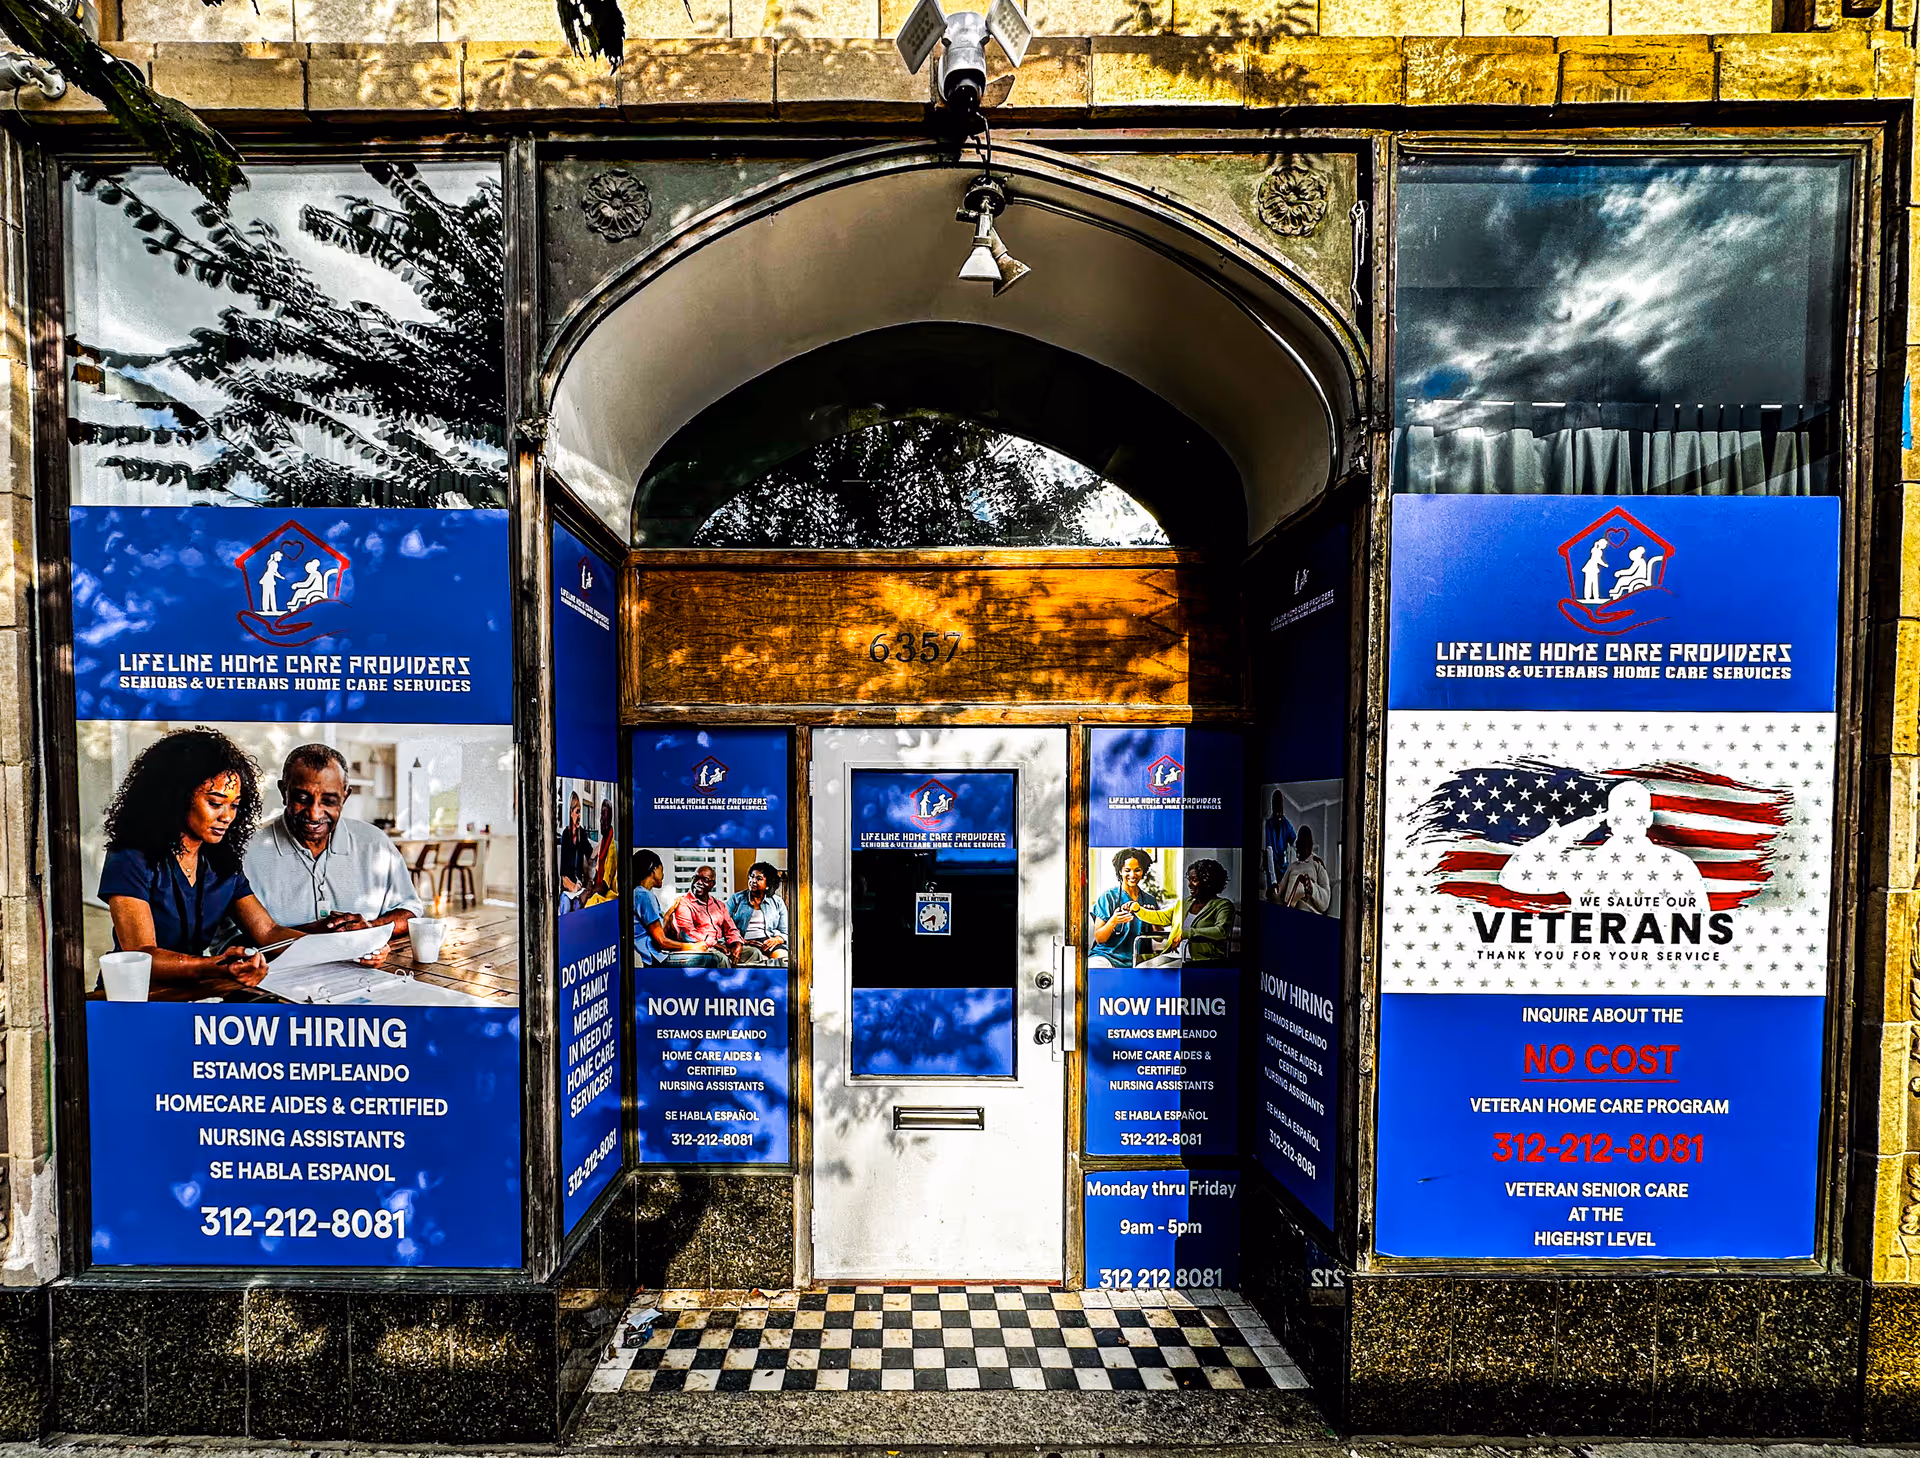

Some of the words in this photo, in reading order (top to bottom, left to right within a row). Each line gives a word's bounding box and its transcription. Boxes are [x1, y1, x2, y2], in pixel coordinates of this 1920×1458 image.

[870, 631, 964, 662] 6357
[1436, 642, 1532, 661] LIFELINE
[1539, 643, 1599, 661] HOME
[1605, 643, 1663, 662] CARE
[1669, 643, 1792, 663] PROVIDERS
[120, 653, 213, 672] LIFELINE
[221, 654, 278, 673] HOME
[286, 655, 342, 673] CARE
[350, 655, 471, 675] PROVIDERS
[1435, 665, 1505, 678] SENIORS
[1507, 665, 1521, 678] &
[1523, 665, 1608, 679] VETERANS
[1613, 666, 1660, 679] HOME
[1665, 666, 1708, 679] CARE
[1713, 666, 1792, 680] SERVICES
[120, 676, 187, 689] SENIORS
[190, 677, 203, 689] &
[205, 677, 289, 690] VETERANS
[294, 678, 341, 691] HOME
[346, 678, 388, 691] CARE
[393, 679, 471, 692] SERVICES
[653, 797, 685, 805] LIFELINE
[687, 797, 706, 805] HOME
[707, 797, 726, 805] CARE
[728, 797, 767, 805] PROVIDERS
[861, 833, 900, 841] LIFELINE
[903, 833, 927, 841] HOME
[929, 833, 953, 841] CARE
[955, 833, 1006, 841] PROVIDERS
[1580, 897, 1600, 907] WE
[1607, 897, 1660, 907] SALUTE
[1667, 897, 1697, 908] OUR
[1473, 912, 1734, 945] VETERANS
[1477, 950, 1526, 960] THANK
[1535, 950, 1564, 960] YOU
[1573, 950, 1601, 961] FOR
[1609, 951, 1649, 961] YOUR
[1657, 951, 1720, 961] SERVICE
[562, 964, 576, 988] DO
[578, 954, 595, 980] YOU
[597, 945, 616, 971] HAVE
[573, 989, 580, 1010] A
[581, 972, 609, 1005] FAMILY
[1261, 971, 1287, 1001] NOW
[1290, 983, 1333, 1024] HIRING
[648, 998, 699, 1016] NOW
[704, 998, 775, 1017] HIRING
[1099, 997, 1151, 1016] NOW
[1155, 997, 1226, 1016] HIRING
[1522, 1007, 1588, 1023] INQUIRE
[1592, 1008, 1648, 1023] ABOUT
[1652, 1009, 1683, 1023] THE
[574, 997, 608, 1036] MEMBER
[194, 1015, 280, 1046] NOW
[289, 1017, 407, 1049] HIRING
[657, 1030, 703, 1039] ESTAMOS
[705, 1030, 767, 1039] EMPLEANDO
[1107, 1029, 1154, 1039] ESTAMOS
[1156, 1029, 1217, 1039] EMPLEANDO
[1264, 1008, 1289, 1030] ESTAMOS
[1290, 1021, 1327, 1050] EMPLEANDO
[569, 1042, 578, 1066] IN
[580, 1027, 601, 1058] NEED
[602, 1017, 613, 1040] OF
[662, 1051, 692, 1060] HOME
[694, 1051, 721, 1061] CARE
[723, 1052, 752, 1061] AIDES
[754, 1052, 761, 1061] &
[1112, 1051, 1143, 1060] HOME
[1144, 1051, 1172, 1060] CARE
[1173, 1051, 1202, 1060] AIDES
[1204, 1051, 1212, 1060] &
[1266, 1033, 1282, 1051] HOME
[1283, 1044, 1299, 1061] CARE
[1299, 1053, 1317, 1073] AIDES
[1318, 1064, 1323, 1076] &
[1524, 1044, 1576, 1074] NO
[1584, 1044, 1680, 1074] COST
[192, 1061, 284, 1080] ESTAMOS
[289, 1063, 410, 1082] EMPLEANDO
[568, 1063, 593, 1095] HOME
[595, 1040, 615, 1071] CARE
[687, 1066, 737, 1076] CERTIFIED
[1137, 1065, 1187, 1075] CERTIFIED
[1279, 1059, 1308, 1085] CERTIFIED
[571, 1065, 613, 1118] SERVICES?
[660, 1081, 704, 1090] NURSING
[706, 1082, 765, 1091] ASSISTANTS
[1109, 1080, 1154, 1090] NURSING
[1155, 1080, 1214, 1090] ASSISTANTS
[155, 1094, 266, 1113] HOMECARE
[270, 1096, 327, 1114] AIDES
[332, 1097, 345, 1115] &
[350, 1097, 448, 1116] CERTIFIED
[1289, 1083, 1324, 1116] ASSISTANTS
[1470, 1098, 1543, 1113] VETERAN
[1547, 1098, 1596, 1113] HOME
[1599, 1099, 1643, 1113] CARE
[1647, 1099, 1729, 1114] PROGRAM
[665, 1111, 677, 1120] SE
[680, 1111, 712, 1120] HABLA
[714, 1109, 759, 1121] ESPAÑOL
[1114, 1111, 1127, 1120] SE
[1129, 1111, 1162, 1120] HABLA
[1164, 1109, 1208, 1120] ESPAÑOL
[199, 1128, 285, 1147] NURSING
[290, 1130, 405, 1149] ASSISTANTS
[671, 1133, 753, 1146] 312-212-8081
[1120, 1133, 1202, 1146] 312-212-8081
[1492, 1132, 1704, 1163] 312-212-8081
[568, 1128, 616, 1197] 312-212-8081
[1269, 1128, 1315, 1180] 312-212-8081
[209, 1161, 233, 1180] SE
[238, 1162, 303, 1181] HABLA
[307, 1163, 396, 1182] ESPANOL
[1086, 1180, 1149, 1199] Monday
[1151, 1181, 1185, 1196] thru
[1189, 1181, 1236, 1199] Friday
[1505, 1182, 1578, 1197] VETERAN
[1581, 1182, 1641, 1198] SENIOR
[1644, 1183, 1689, 1198] CARE
[200, 1206, 405, 1239] 312-212-8081
[1568, 1207, 1589, 1221] AT
[1591, 1207, 1624, 1222] THE
[1120, 1219, 1154, 1235] 9am
[1167, 1219, 1202, 1237] 5pm
[1534, 1231, 1604, 1246] HIGEHST
[1607, 1232, 1656, 1247] LEVEL
[1099, 1268, 1133, 1289] 312
[1137, 1268, 1171, 1289] 212
[1175, 1268, 1222, 1288] 8081
